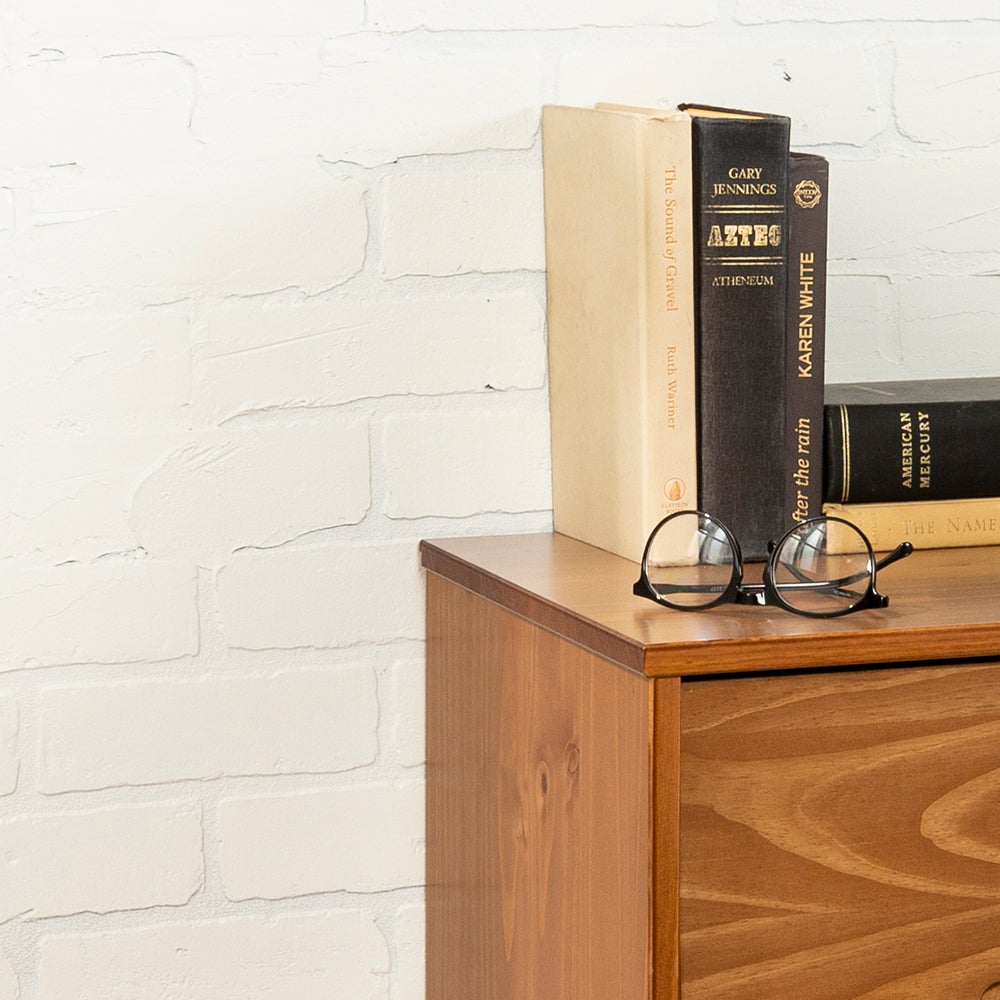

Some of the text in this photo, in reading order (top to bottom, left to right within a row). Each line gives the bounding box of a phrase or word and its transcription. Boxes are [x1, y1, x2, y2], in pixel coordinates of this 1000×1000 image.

[711, 183, 777, 198] JENNINGS
[728, 167, 763, 180] GARY
[663, 166, 679, 312] The Sound of Gravel
[707, 224, 782, 247] AZTEC
[712, 275, 774, 287] ATHENEUM
[798, 252, 814, 378] KAREN WHITE
[667, 345, 678, 430] Ruth Wariner
[791, 418, 811, 525] fter the rain
[900, 412, 913, 489] AMERICAN
[918, 411, 931, 489] MERCURY
[903, 520, 936, 535] THE
